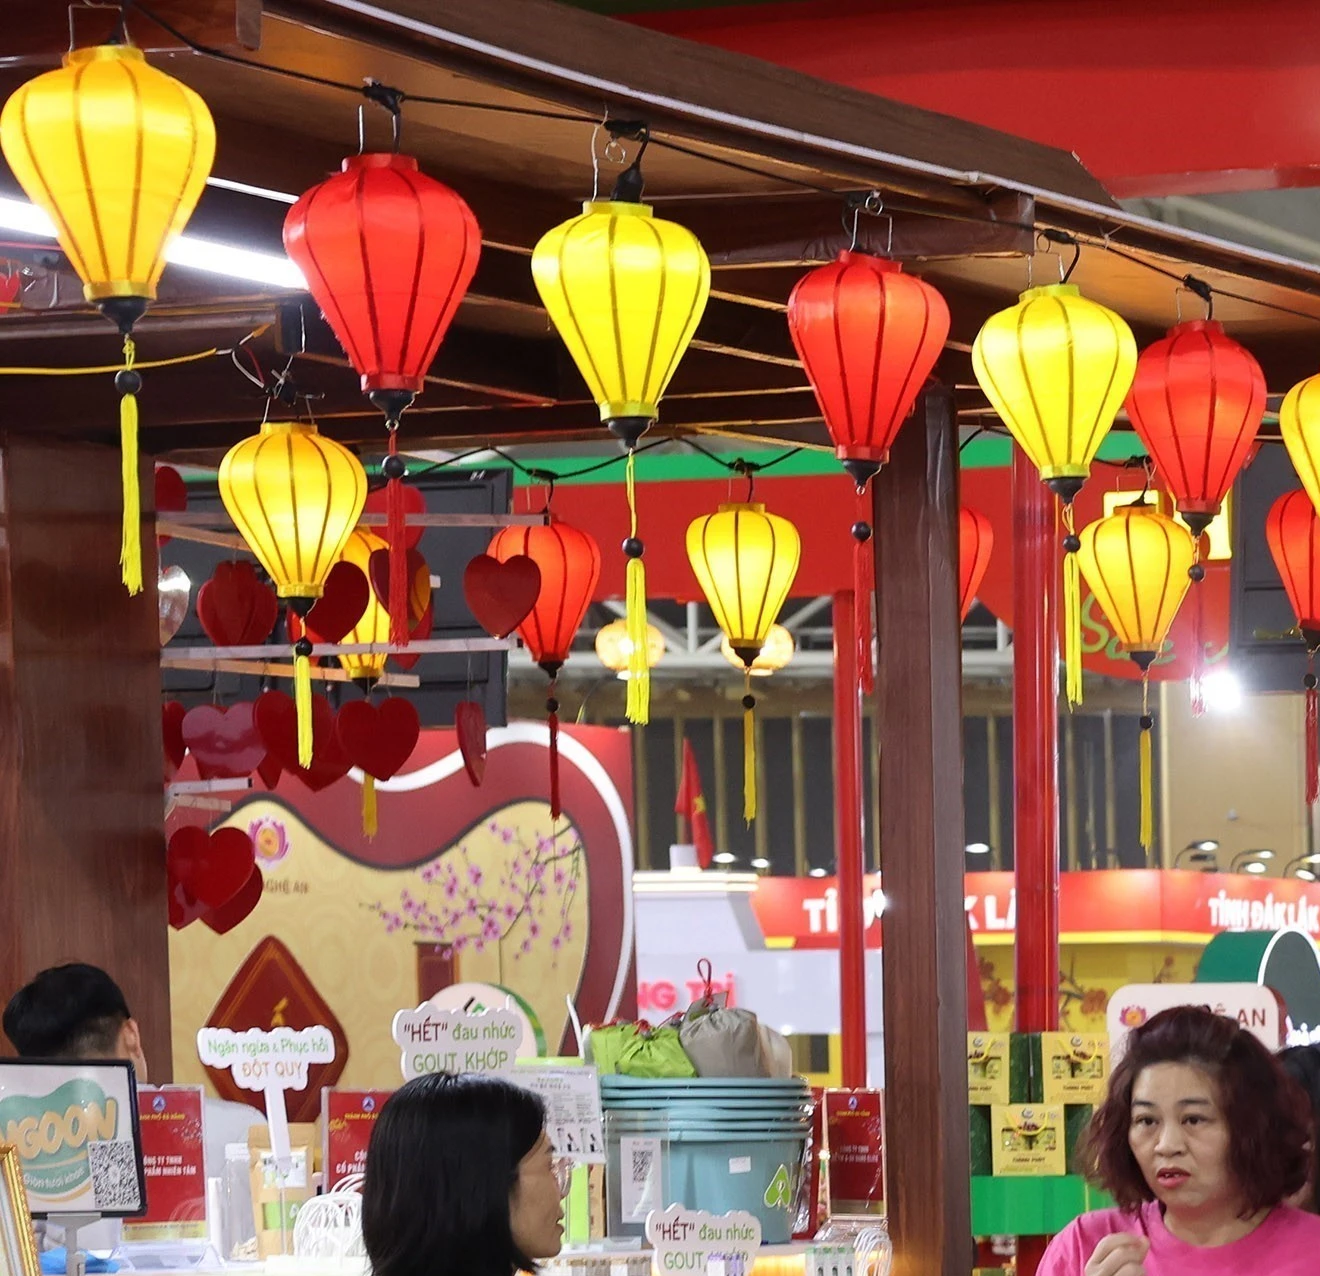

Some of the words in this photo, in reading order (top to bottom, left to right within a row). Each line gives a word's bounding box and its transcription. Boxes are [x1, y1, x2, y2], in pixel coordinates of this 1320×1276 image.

[452, 1026, 478, 1040] đau
[483, 1021, 516, 1040] nhức
[208, 1039, 239, 1057] Ngăn
[242, 1040, 270, 1057] ngừa
[280, 1038, 309, 1055] Phục
[312, 1036, 329, 1052] hồi
[242, 1060, 269, 1080] ĐỘT
[413, 1053, 461, 1074] GOUT,
[465, 1048, 508, 1072] KHỚP
[699, 1225, 722, 1240] đau
[725, 1223, 754, 1240] nhức
[664, 1251, 708, 1273] GOUT,
